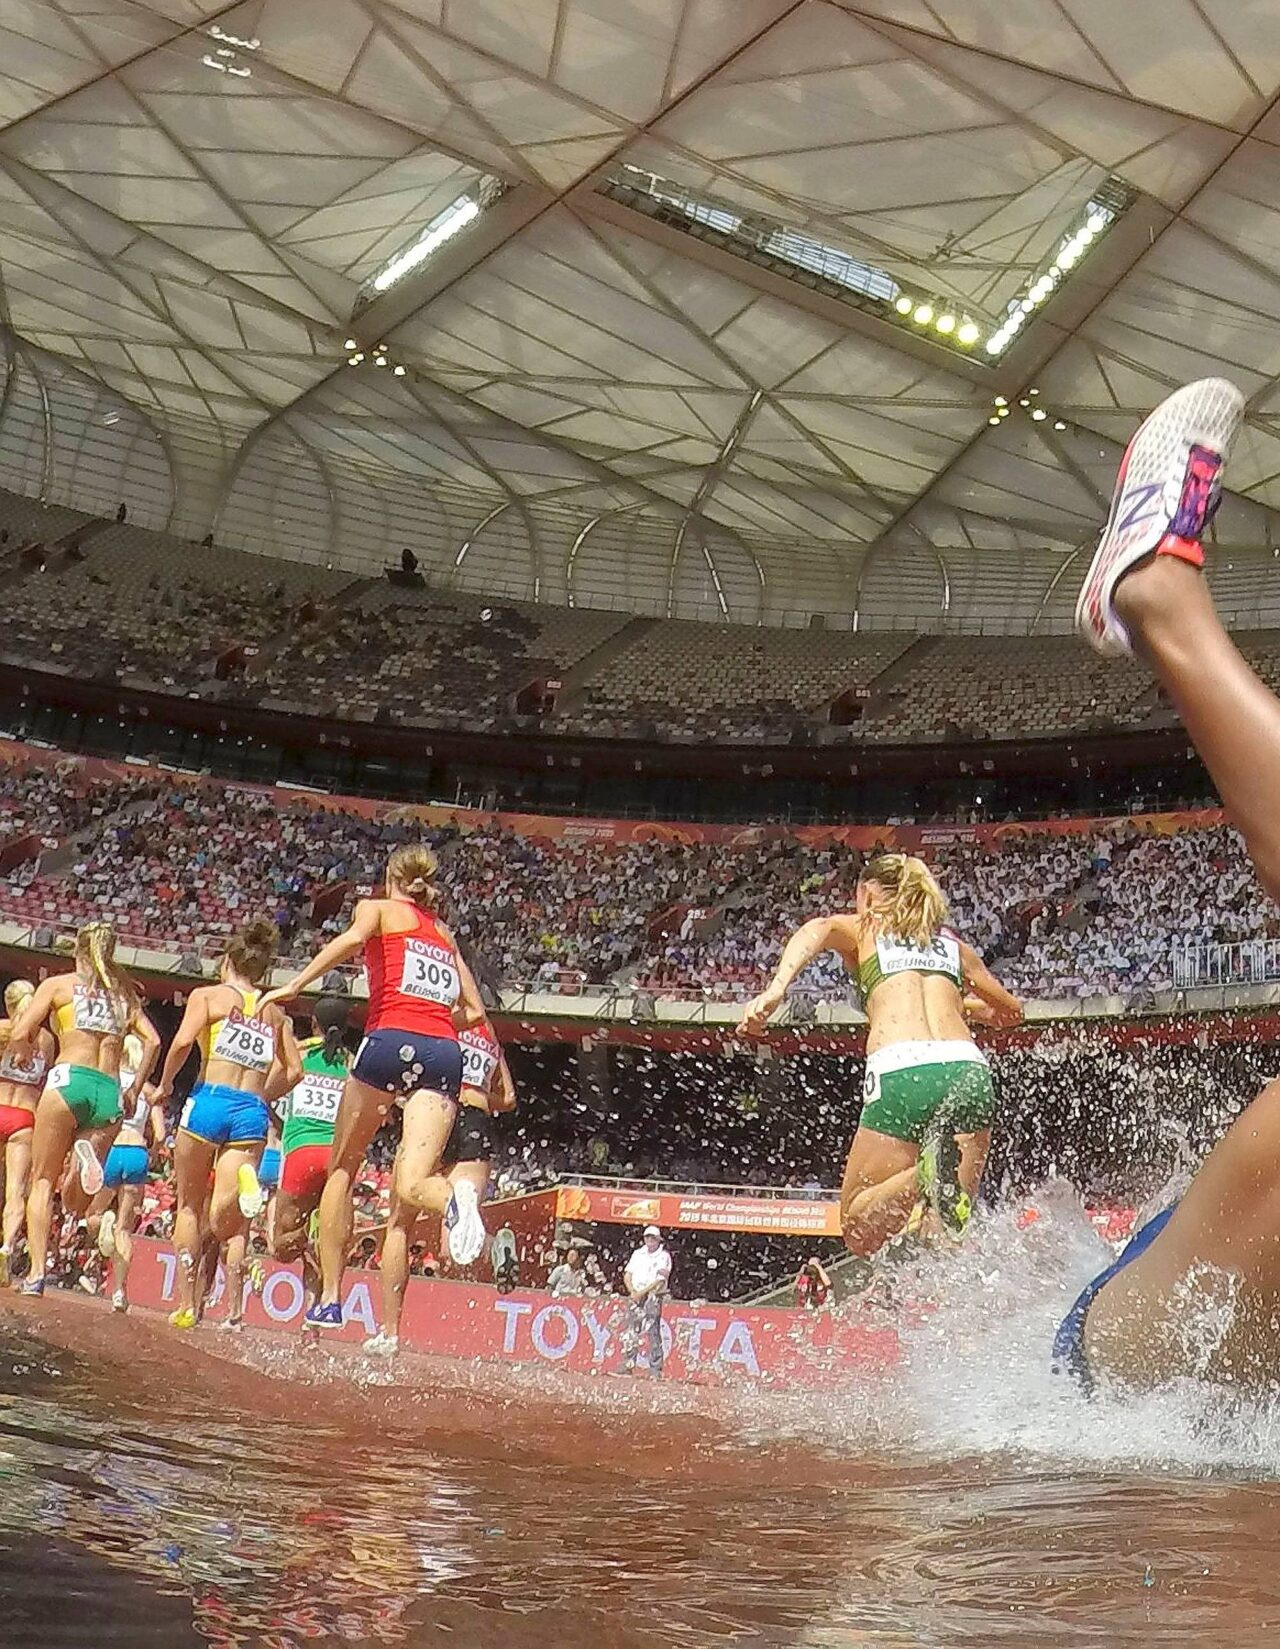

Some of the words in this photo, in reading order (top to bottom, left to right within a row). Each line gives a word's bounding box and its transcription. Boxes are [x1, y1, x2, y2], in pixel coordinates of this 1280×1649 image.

[894, 935, 949, 958] 48
[415, 958, 453, 990] 309
[227, 1027, 265, 1056] 788
[303, 1074, 346, 1090] OYOTA
[303, 1089, 337, 1110] 335
[156, 1252, 378, 1336] TOA
